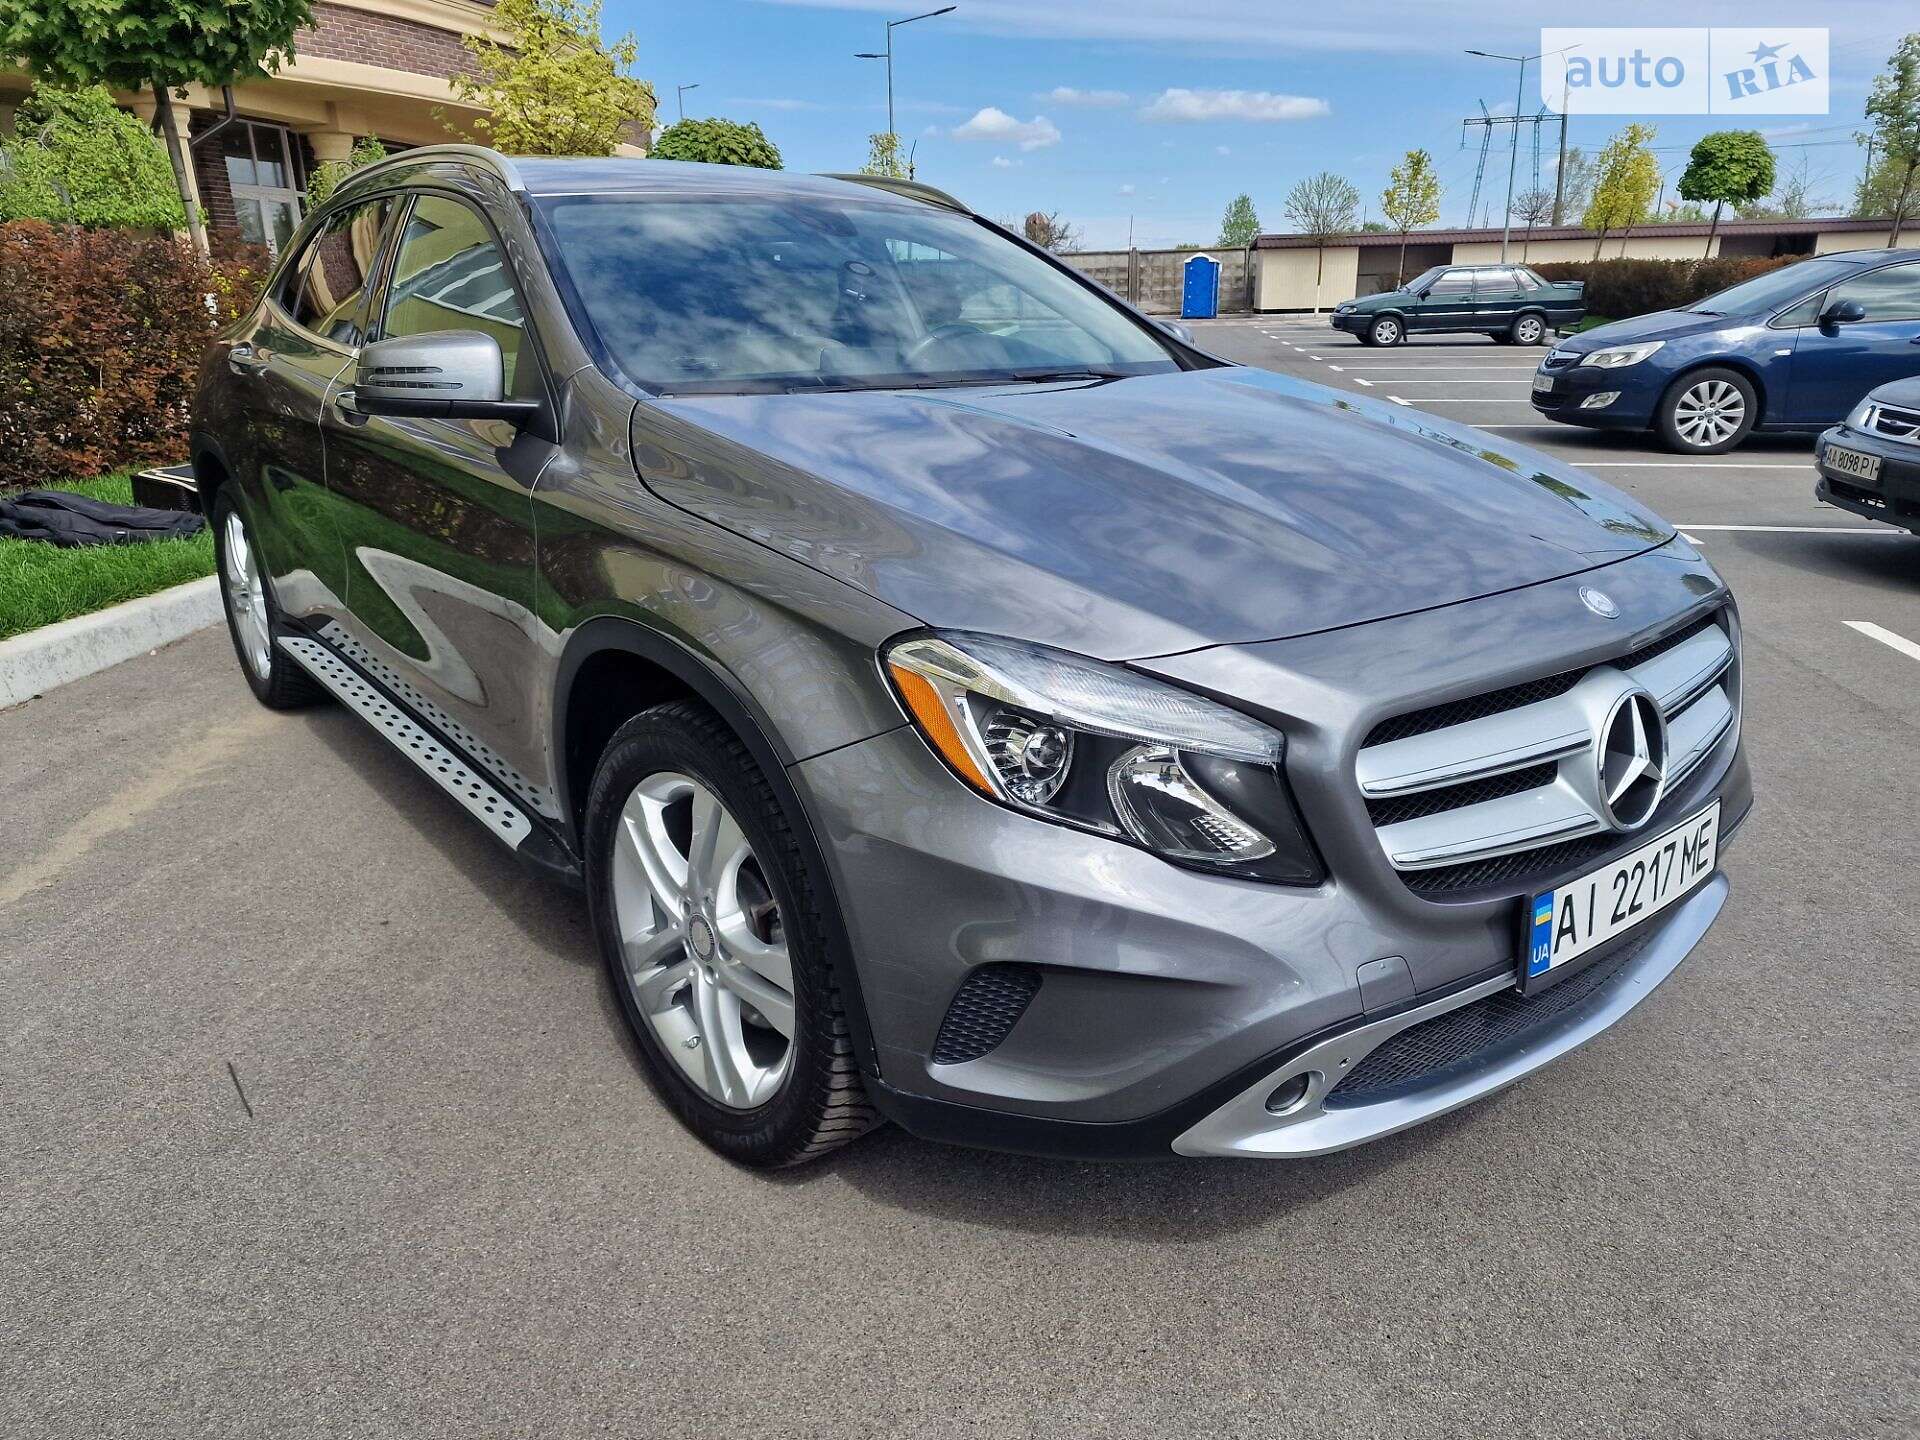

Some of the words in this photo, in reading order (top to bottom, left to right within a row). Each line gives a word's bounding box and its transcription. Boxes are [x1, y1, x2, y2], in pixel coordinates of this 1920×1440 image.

[1826, 447, 1837, 465] AA
[1838, 452, 1860, 471] 8098
[1860, 457, 1876, 476] PI
[1554, 883, 1595, 954] AI
[1610, 841, 1676, 926] 2217
[1679, 818, 1713, 885] ME
[1532, 943, 1549, 963] UA
